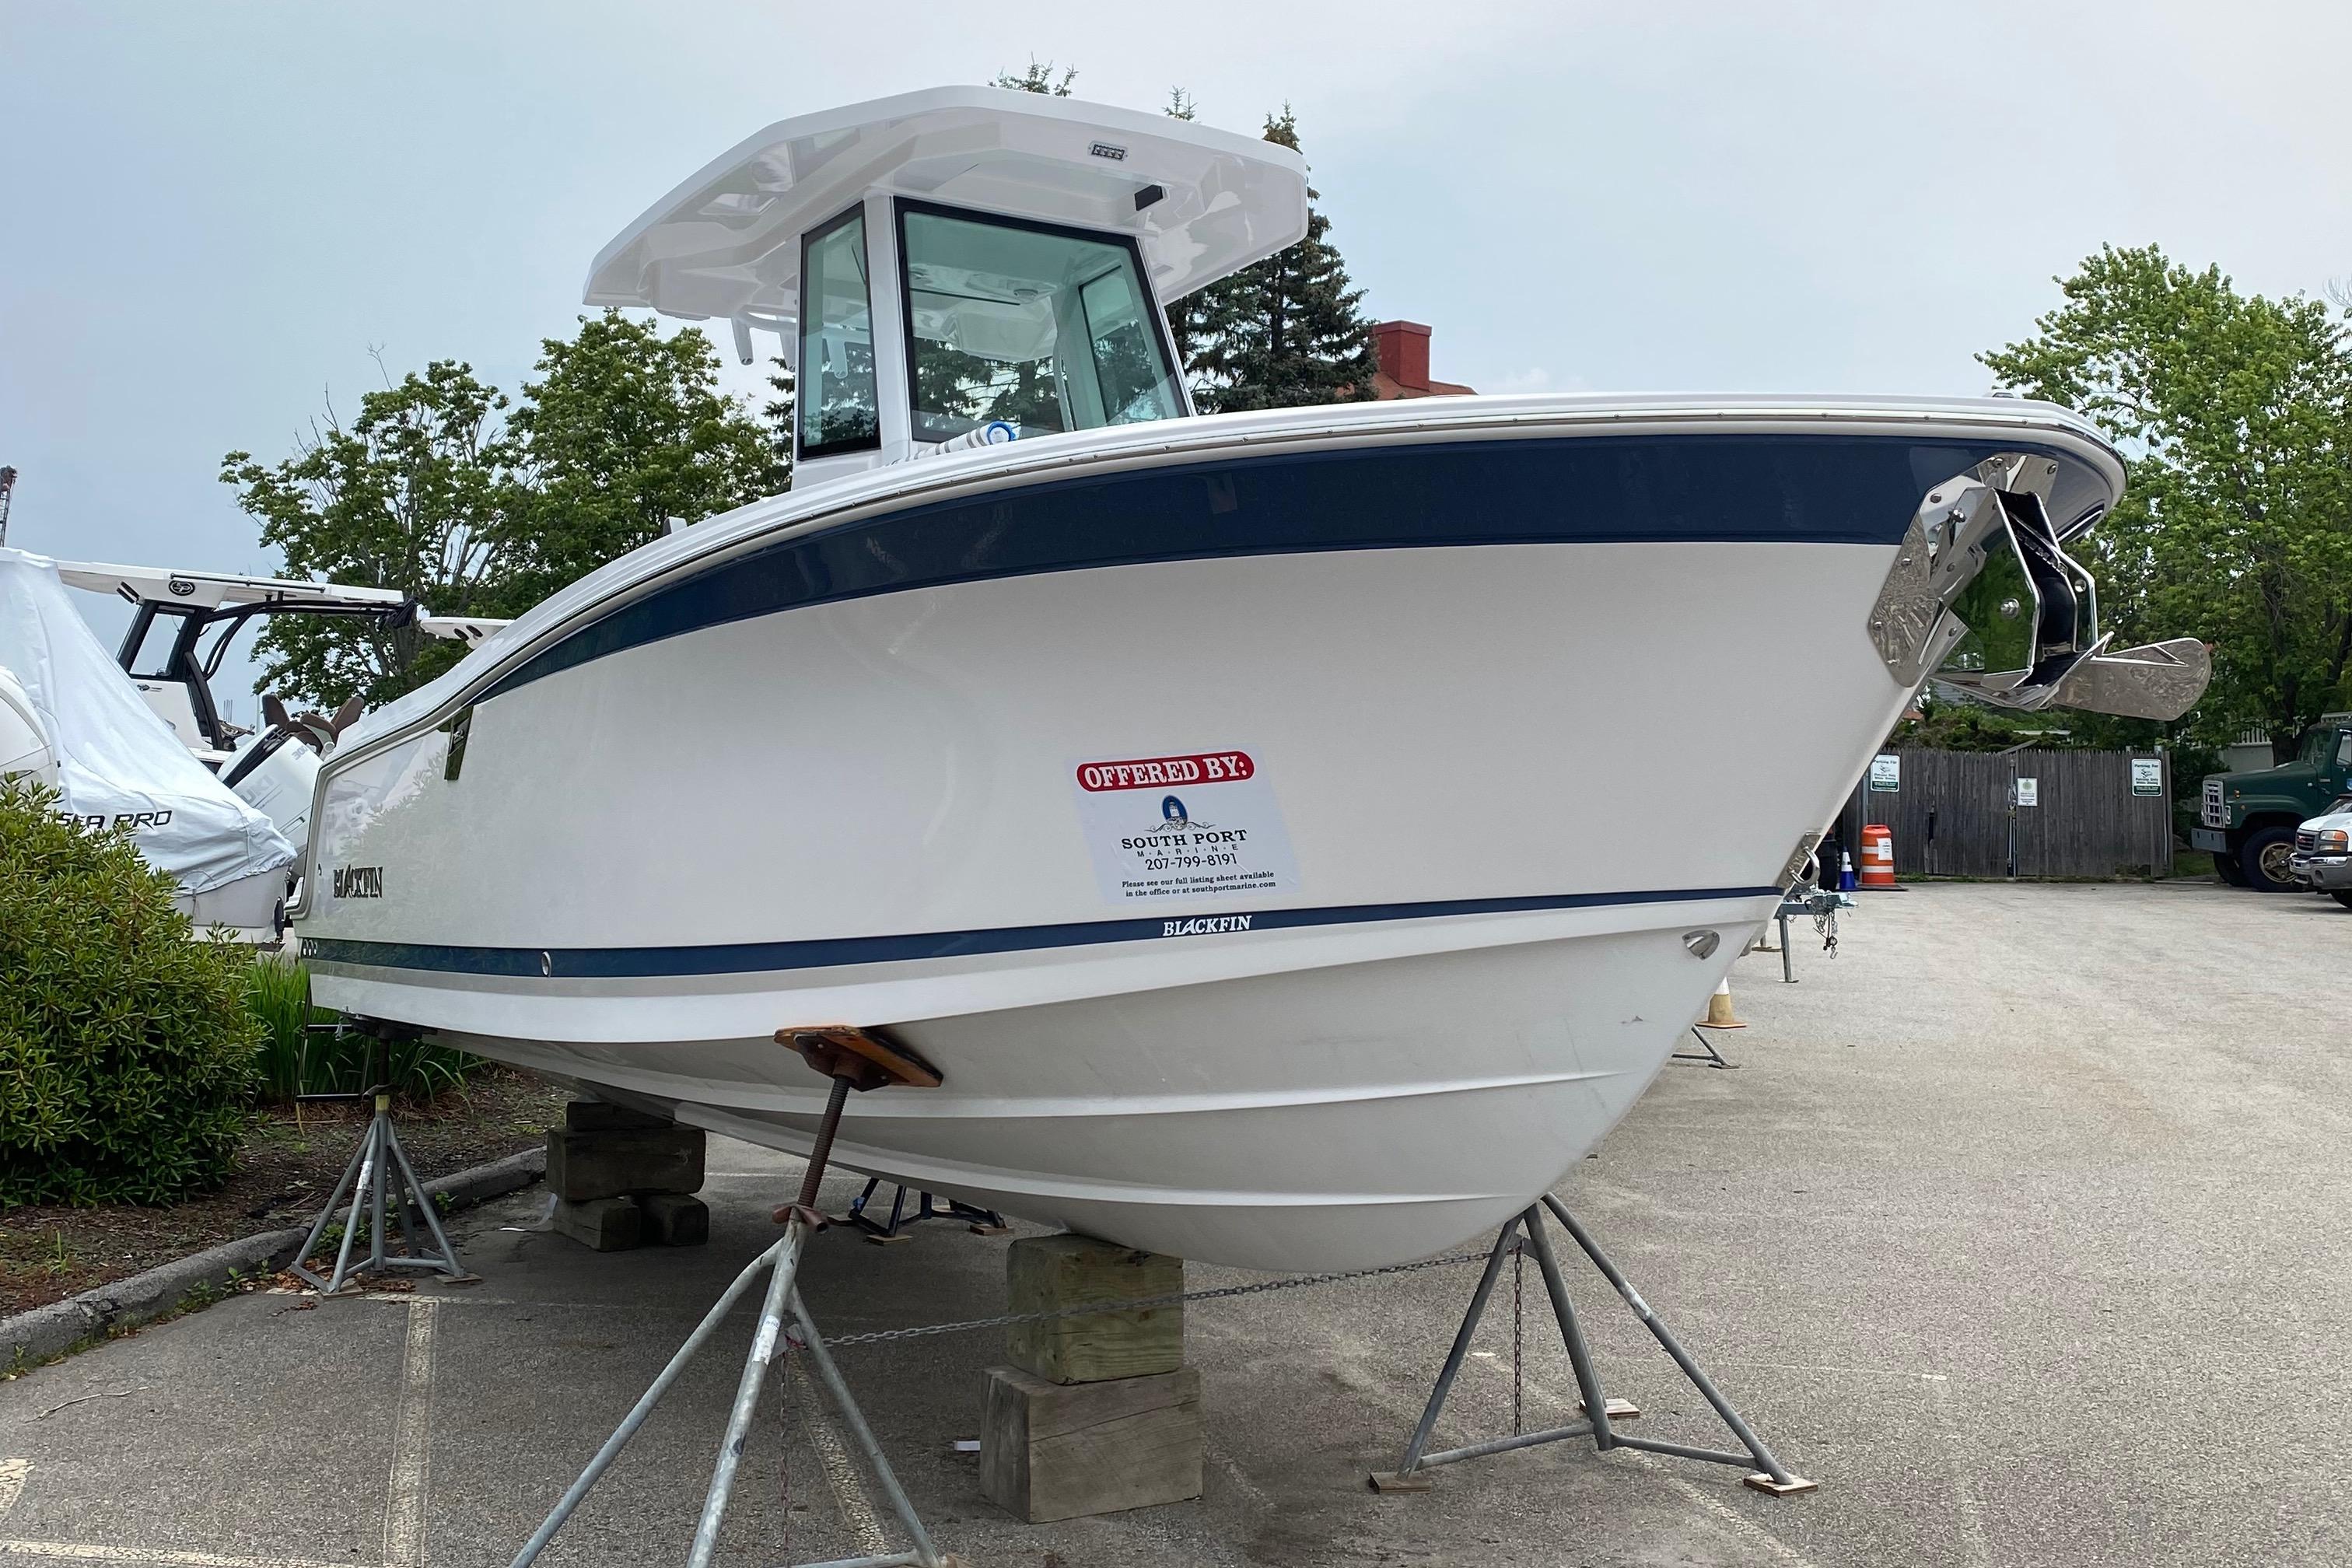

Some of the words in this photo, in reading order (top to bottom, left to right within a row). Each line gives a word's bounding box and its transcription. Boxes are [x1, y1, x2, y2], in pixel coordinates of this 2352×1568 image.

[1084, 760, 1199, 788] OFFERED
[1202, 755, 1247, 779] BY:
[57, 813, 106, 829] SEA
[113, 810, 172, 830] PRO
[1121, 834, 1188, 849] SOUTH
[1193, 829, 1247, 845] PORT
[1145, 853, 1237, 870] 207-799-8191
[333, 864, 383, 898] BLACKFIN
[1240, 871, 1274, 880] available
[1192, 881, 1276, 894] southportmarine.com
[1163, 915, 1252, 936] BLACKFIN
